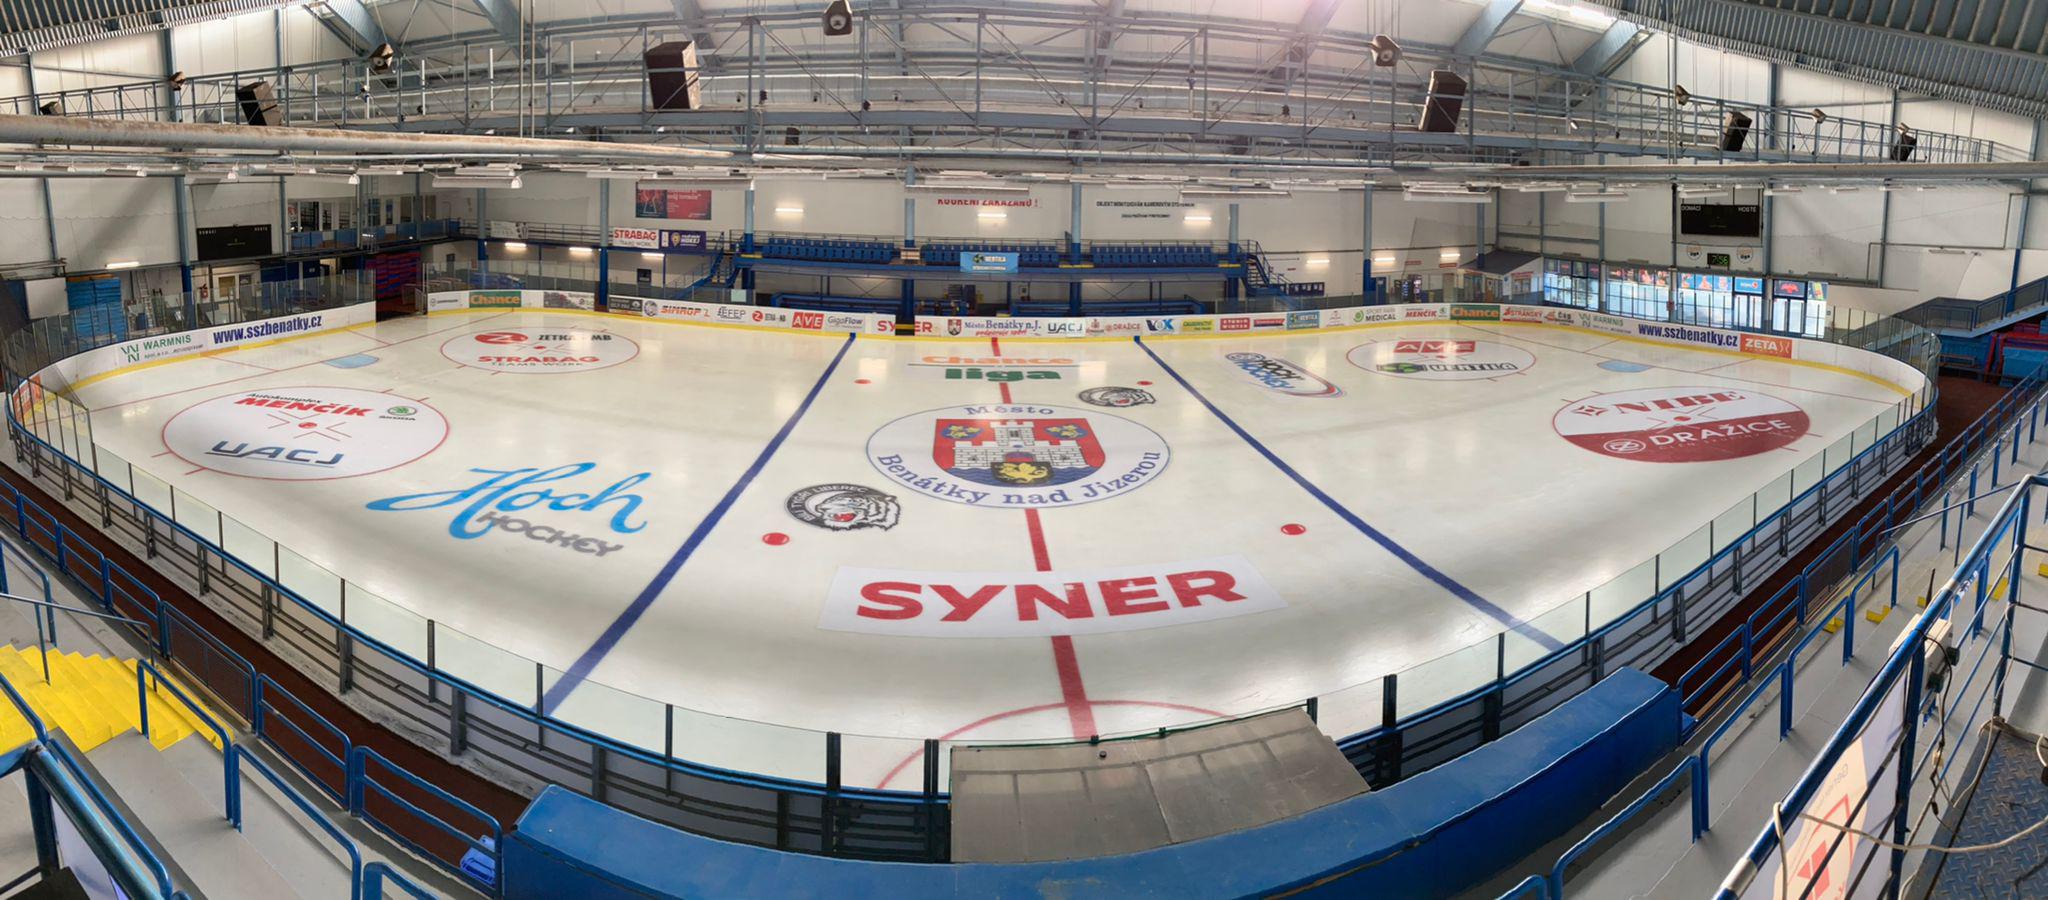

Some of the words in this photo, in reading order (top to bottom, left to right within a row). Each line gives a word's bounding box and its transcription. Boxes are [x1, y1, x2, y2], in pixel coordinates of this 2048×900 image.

[614, 229, 657, 241] STRABAG
[470, 294, 520, 305] Chance
[1365, 313, 1396, 322] MEDICAL
[1451, 308, 1499, 318] Chance
[793, 314, 823, 329] AVE
[876, 320, 933, 333] SYER
[986, 319, 1024, 330] Benátky
[213, 315, 322, 345] www.sszbenatky.cz
[1638, 323, 1738, 347] www.sszbenatky.cz
[143, 334, 192, 350] WARMNIS
[1745, 338, 1778, 350] ZETA
[478, 355, 600, 363] STRABAG
[922, 356, 1074, 365] Chance
[945, 368, 1061, 382] liga
[233, 397, 376, 417] MENČÍK
[1614, 391, 1746, 415] NIBE
[966, 405, 1055, 416] Město
[1649, 419, 1792, 446] DRAŽICE
[205, 440, 344, 466] UACJ
[878, 453, 991, 505] Benátky
[1003, 489, 1073, 504] nad
[1083, 451, 1161, 499] Jizerou
[813, 484, 869, 493] LIBEREC
[365, 461, 648, 539] Hoch
[476, 511, 623, 557] HOCKEY
[856, 569, 1248, 622] SYNER
